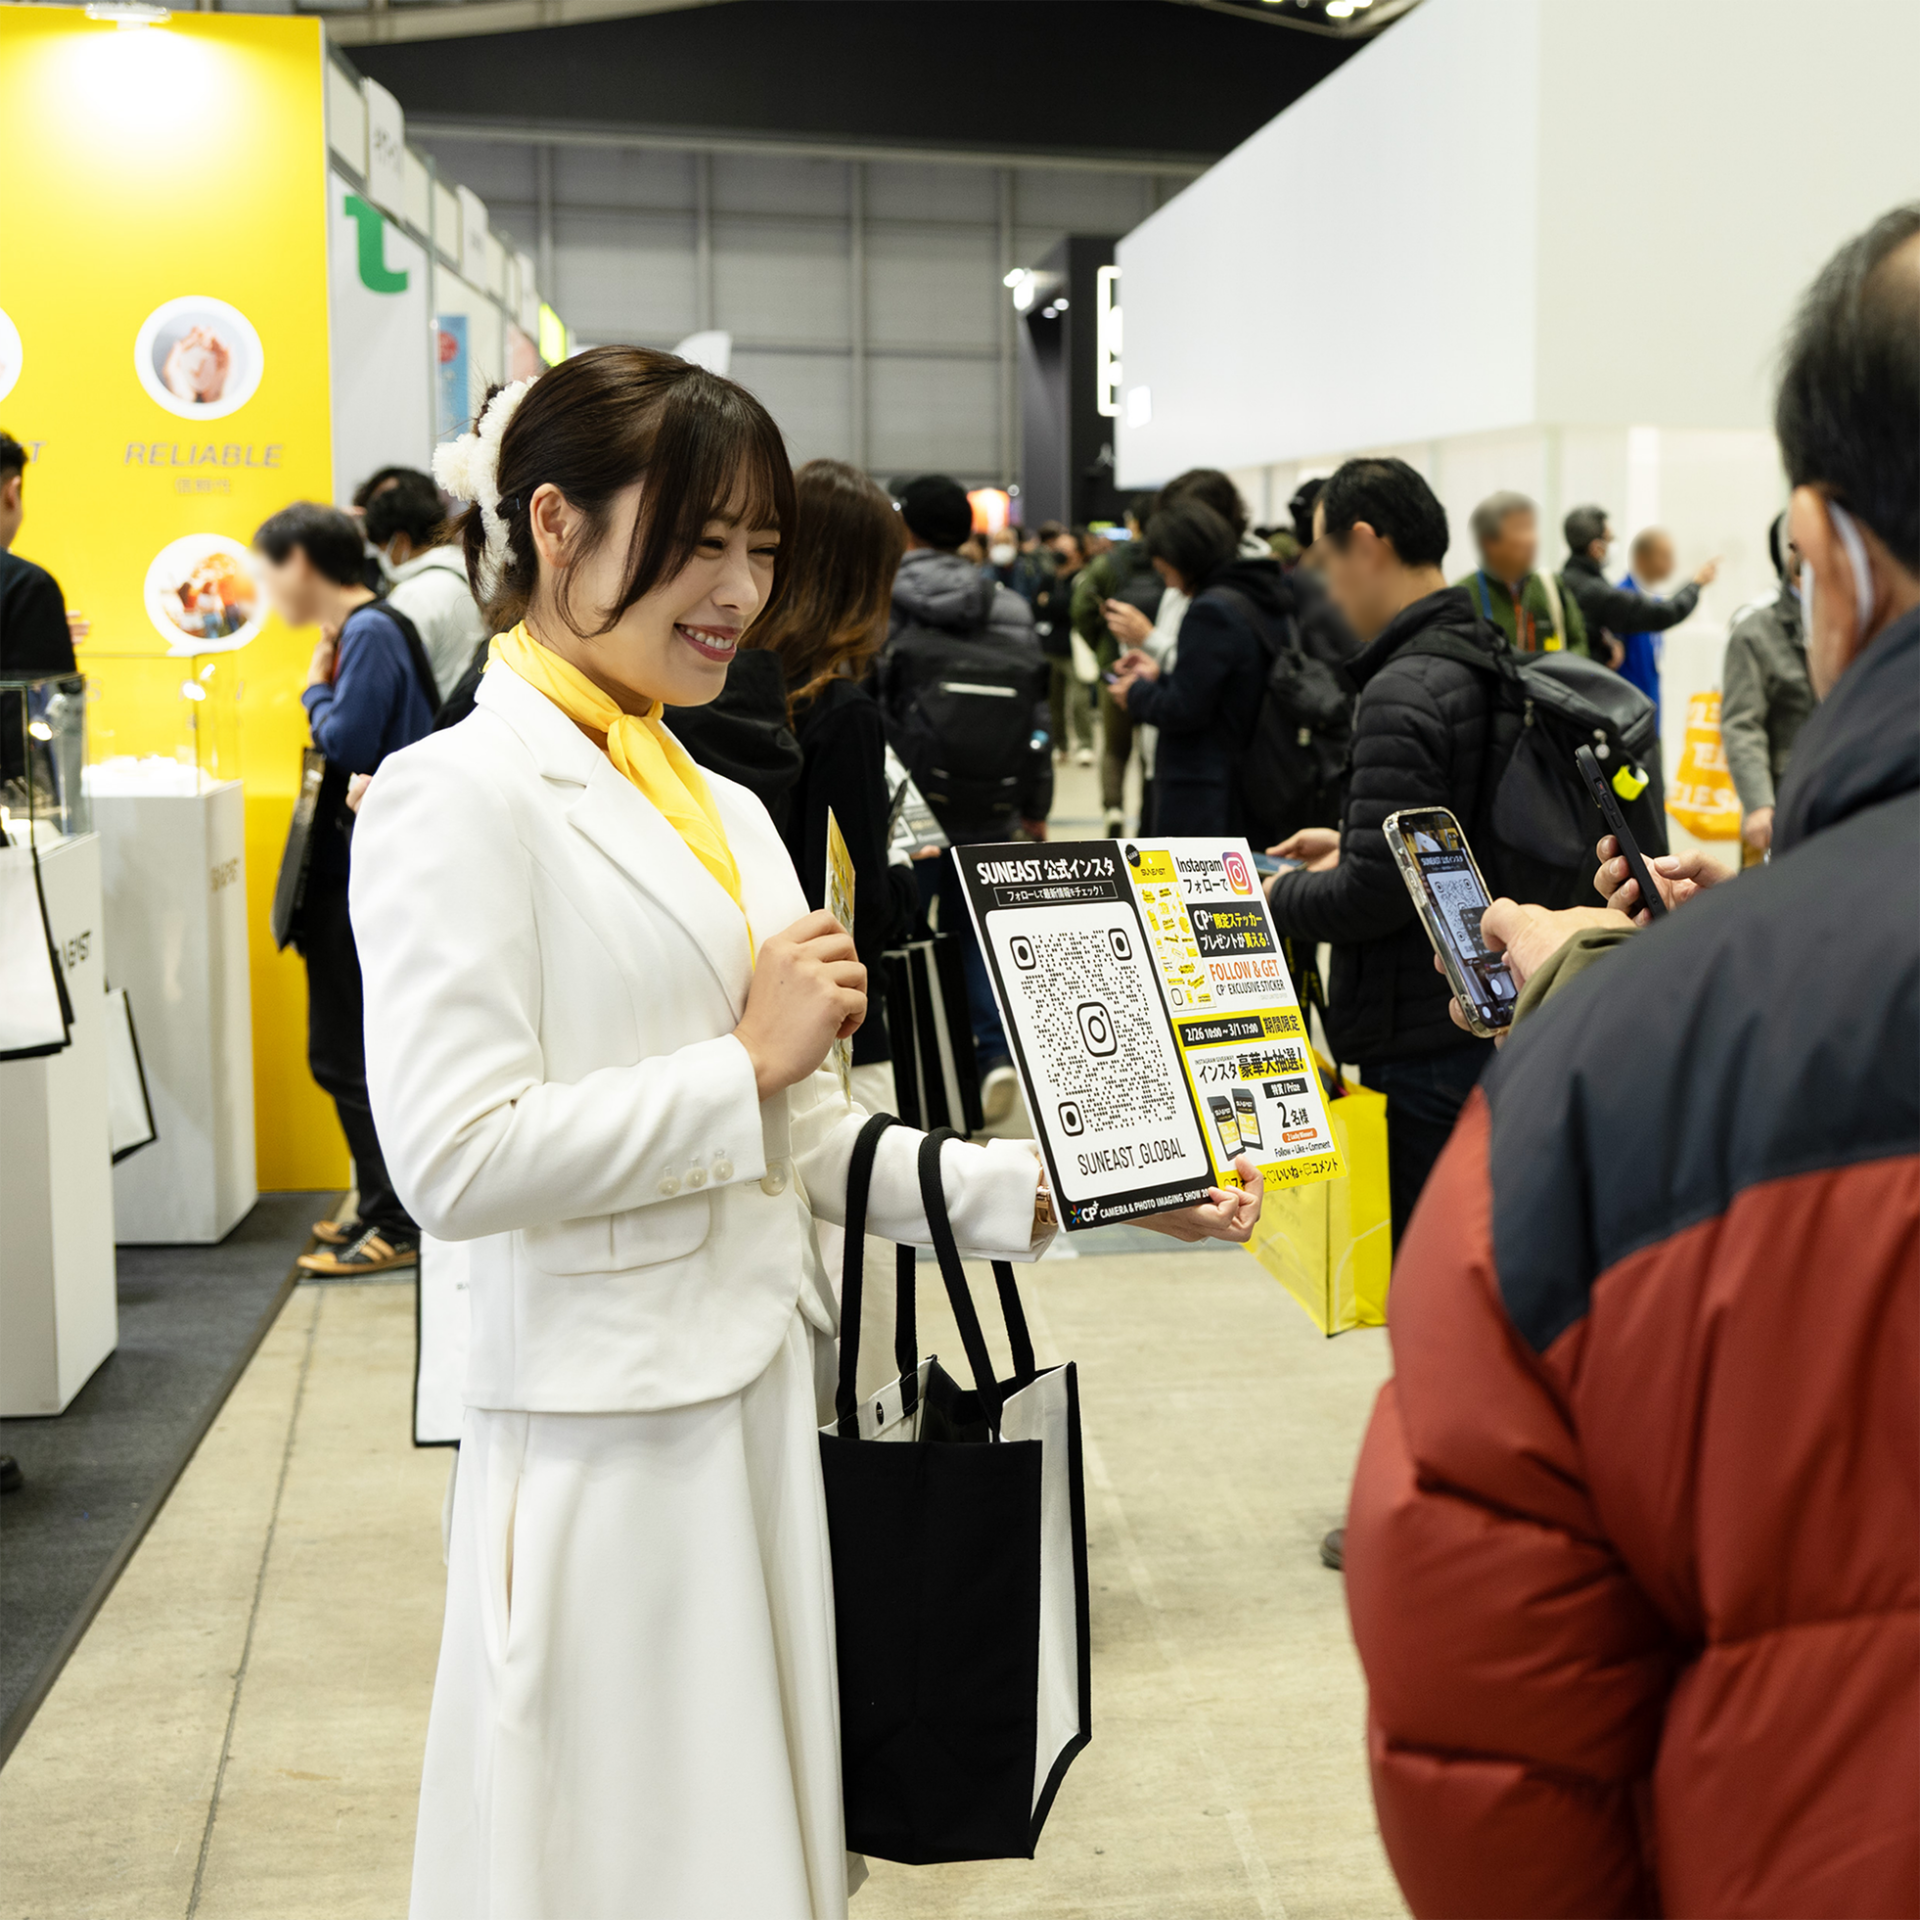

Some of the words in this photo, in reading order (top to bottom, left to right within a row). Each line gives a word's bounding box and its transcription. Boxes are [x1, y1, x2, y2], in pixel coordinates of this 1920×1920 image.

[124, 441, 284, 469] RELIABLE
[976, 859, 1043, 885] SUNEAST
[1043, 856, 1115, 880] 公式インスタ
[1176, 857, 1224, 876] Instagram
[1183, 878, 1229, 895] フォローで
[1209, 961, 1252, 982] FOLLOW
[1252, 960, 1262, 978] &
[1261, 959, 1280, 978] GET
[1227, 980, 1261, 995] EXCLUSIVE
[1260, 978, 1286, 993] STICKER
[1185, 1026, 1205, 1042] 2/26
[1204, 1027, 1223, 1039] 10:00
[1228, 1022, 1241, 1037] 3/1
[1241, 1022, 1259, 1035] 17:00
[1263, 1015, 1301, 1034] 期間限定
[1077, 1137, 1187, 1176] SUNEAST_GLOBAL
[1274, 1147, 1291, 1158] Follow
[1294, 1144, 1306, 1154] Like
[1308, 1140, 1331, 1152] Comment
[1275, 1165, 1300, 1182] いいね
[1311, 1157, 1339, 1175] コメント
[1099, 1204, 1129, 1219] CAMERA
[1128, 1203, 1135, 1212] &
[1134, 1199, 1157, 1212] PHOTO
[1156, 1194, 1184, 1208] IMAGING
[1183, 1189, 1201, 1202] SHOW
[1200, 1188, 1209, 1198] 20
